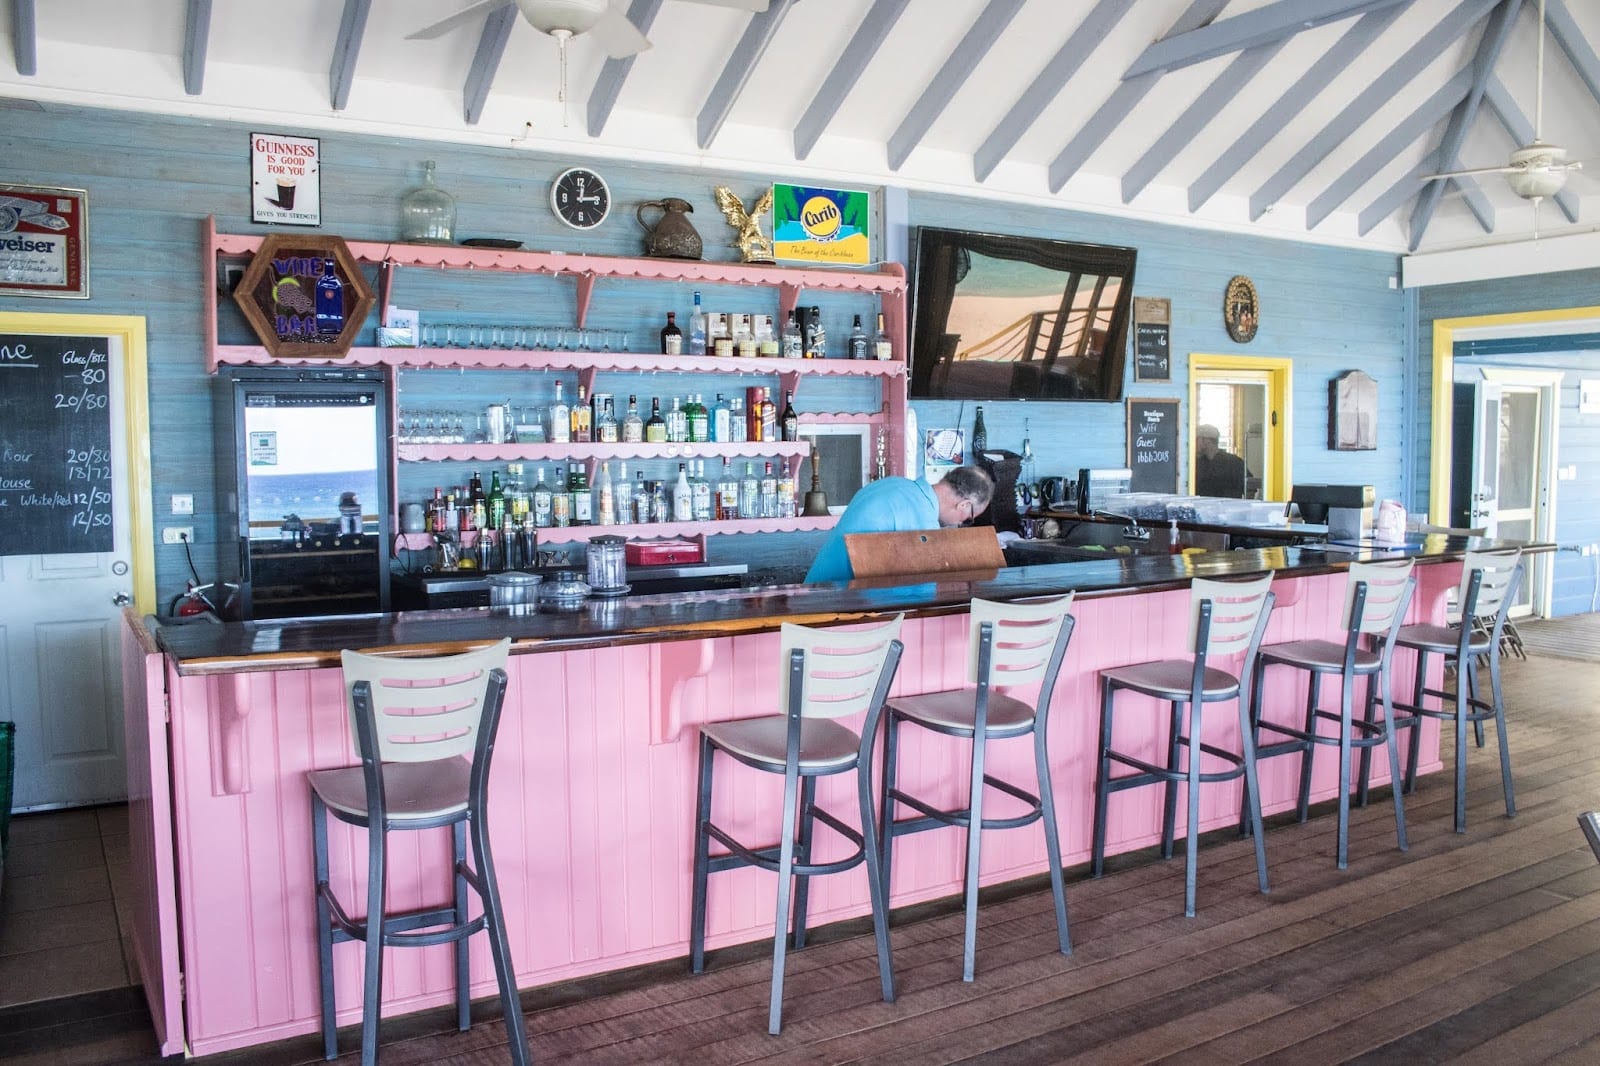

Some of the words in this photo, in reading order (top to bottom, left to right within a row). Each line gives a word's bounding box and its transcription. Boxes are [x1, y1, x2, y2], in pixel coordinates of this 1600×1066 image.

[255, 138, 315, 157] GUINNESS
[267, 155, 276, 163] IS
[281, 156, 305, 166] GOOD
[267, 165, 286, 174] FOR
[288, 167, 305, 176] YOU
[577, 177, 585, 187] 12
[289, 212, 318, 220] STRENGTH
[578, 211, 584, 222] 6
[804, 204, 838, 227] Carib
[791, 245, 800, 254] The
[820, 249, 829, 257] the
[54, 388, 107, 413] 20/80
[1136, 436, 1157, 448] Guest
[0, 477, 34, 489] ouse
[73, 486, 111, 512] 12/50
[72, 509, 112, 535] 12/50
